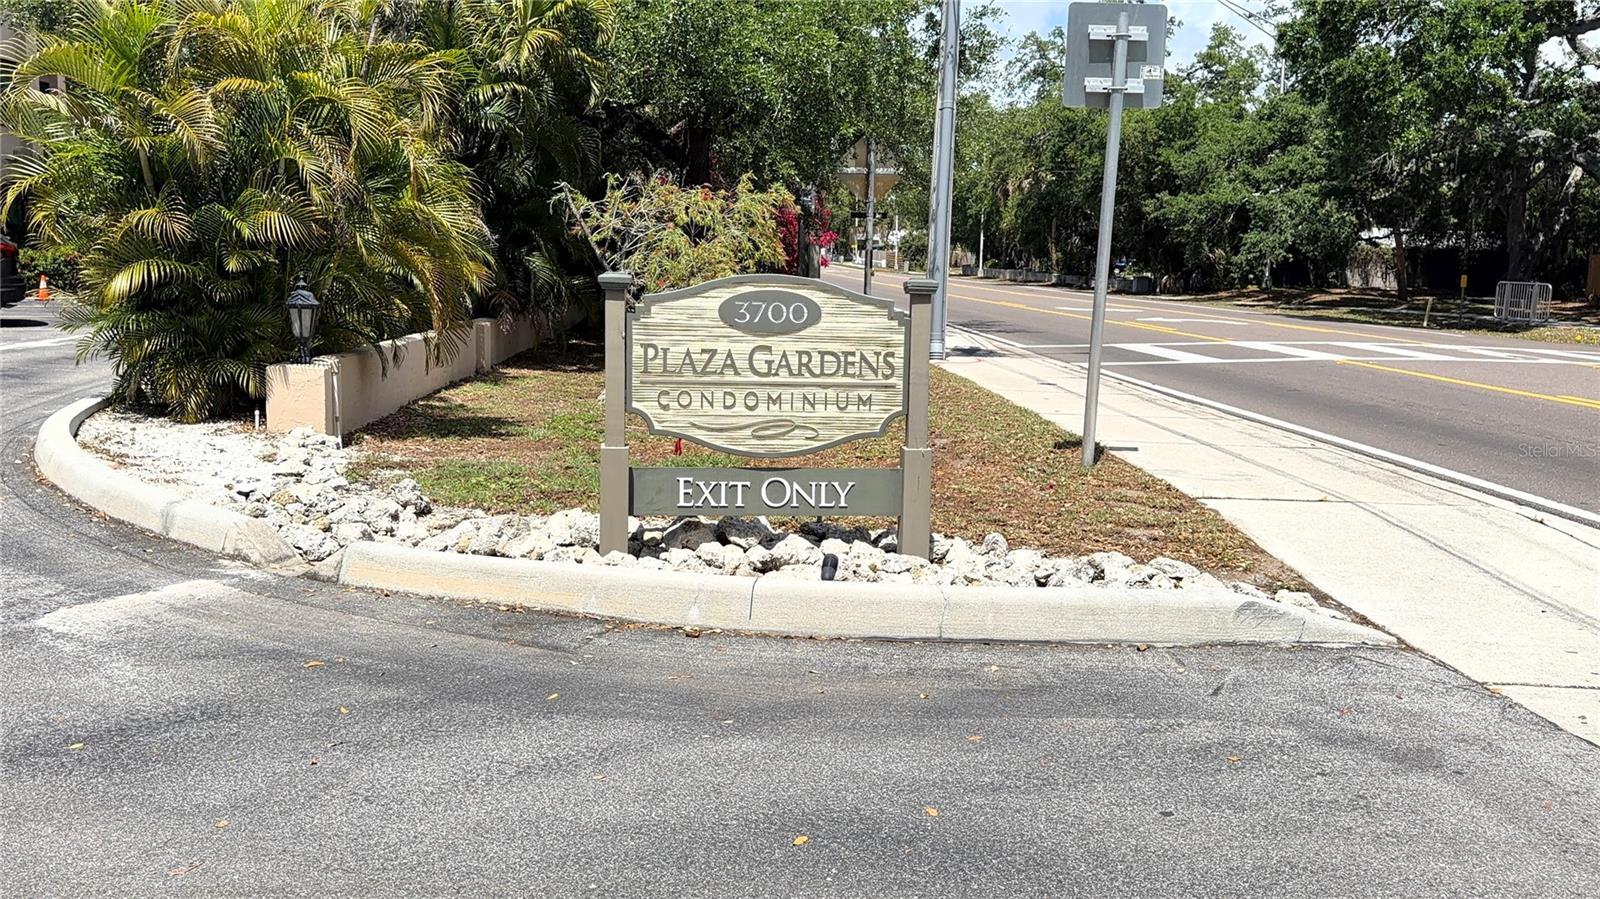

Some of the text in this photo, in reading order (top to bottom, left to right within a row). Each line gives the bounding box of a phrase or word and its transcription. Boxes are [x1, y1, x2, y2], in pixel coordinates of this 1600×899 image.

[734, 302, 808, 323] 3700
[640, 343, 896, 379] PLAZA GARDENS
[657, 390, 873, 412] CONDOMINIUM
[676, 477, 855, 509] EXIT ONLY
